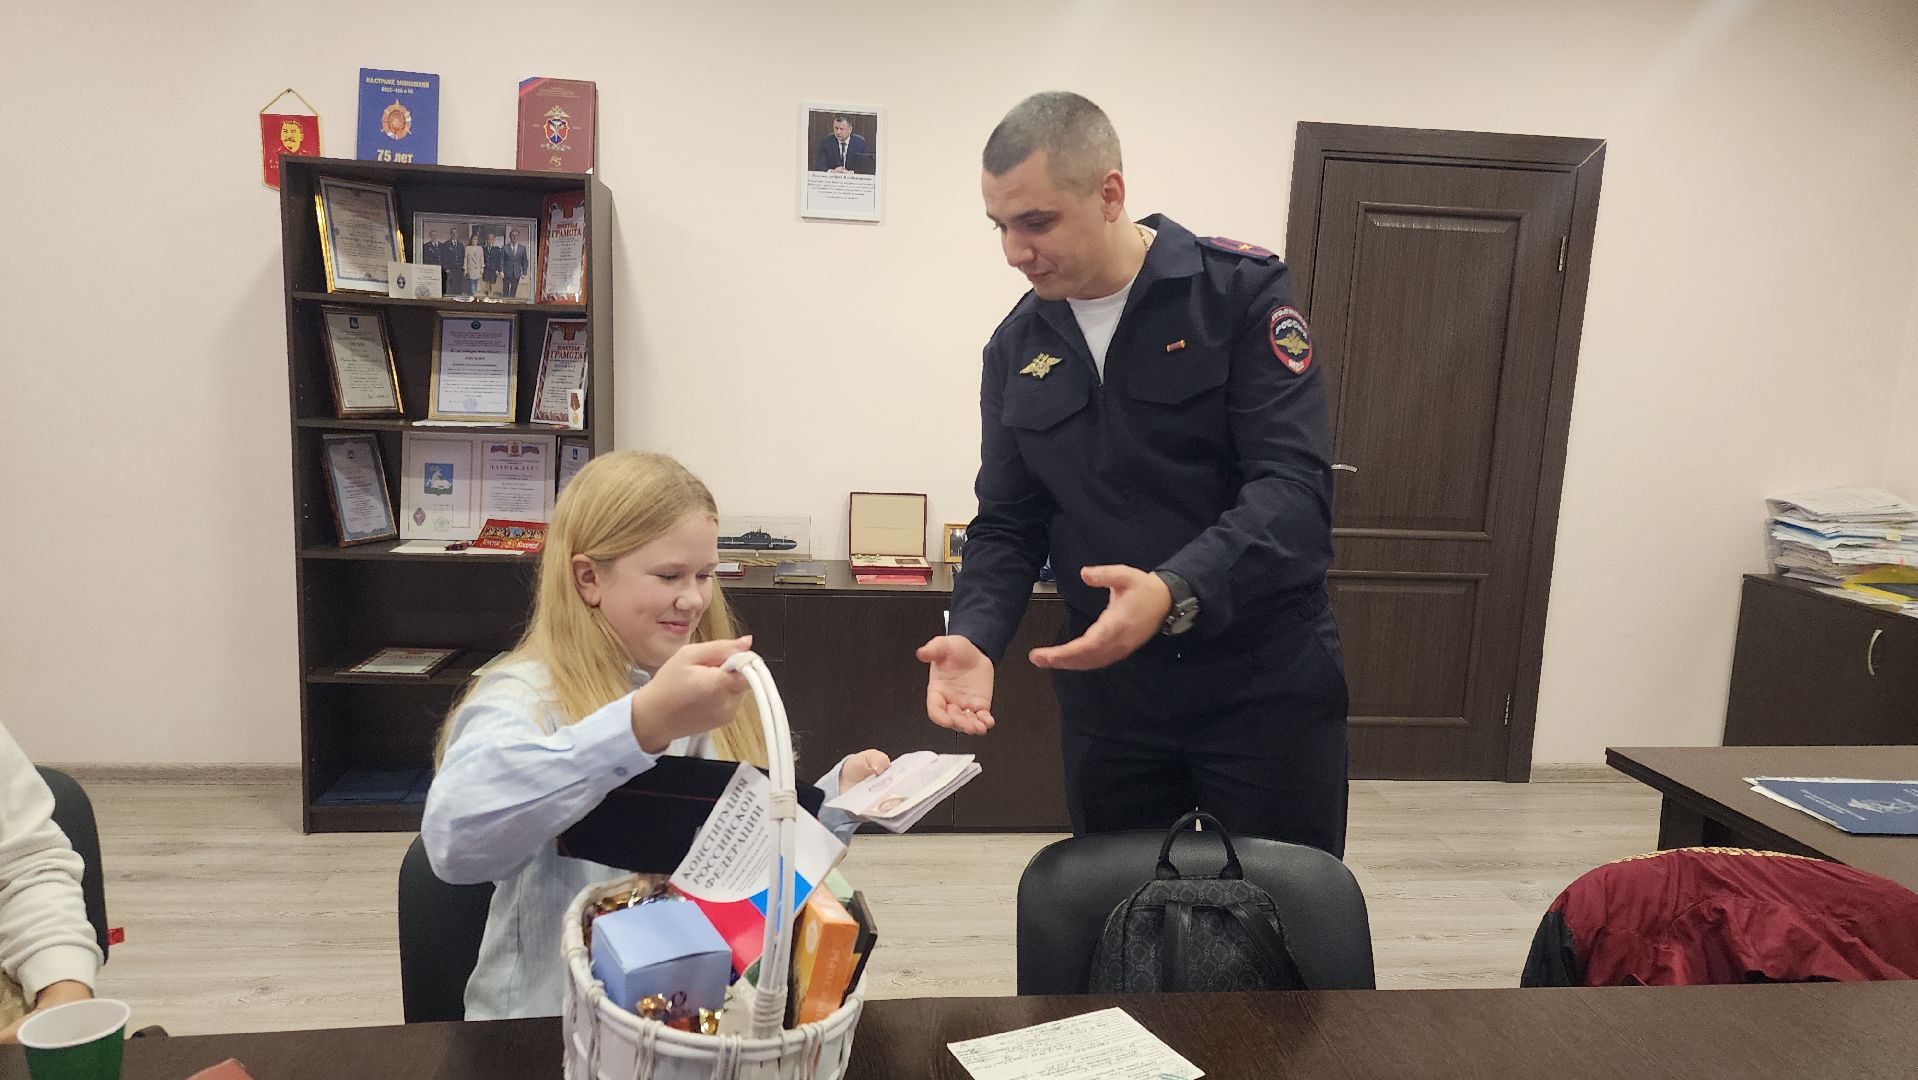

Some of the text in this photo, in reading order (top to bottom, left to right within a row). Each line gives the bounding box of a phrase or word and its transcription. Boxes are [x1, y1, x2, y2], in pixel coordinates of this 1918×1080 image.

[377, 149, 414, 164] 75 лет
[551, 228, 582, 238] ГРАМОТА
[549, 350, 583, 360] ГРАМОТА
[682, 778, 749, 880] КОНСТИТУЦИЯ
[693, 790, 757, 885] РОССИЙСКОЙ
[705, 805, 765, 889] ФЕДЕРАЦИИ
